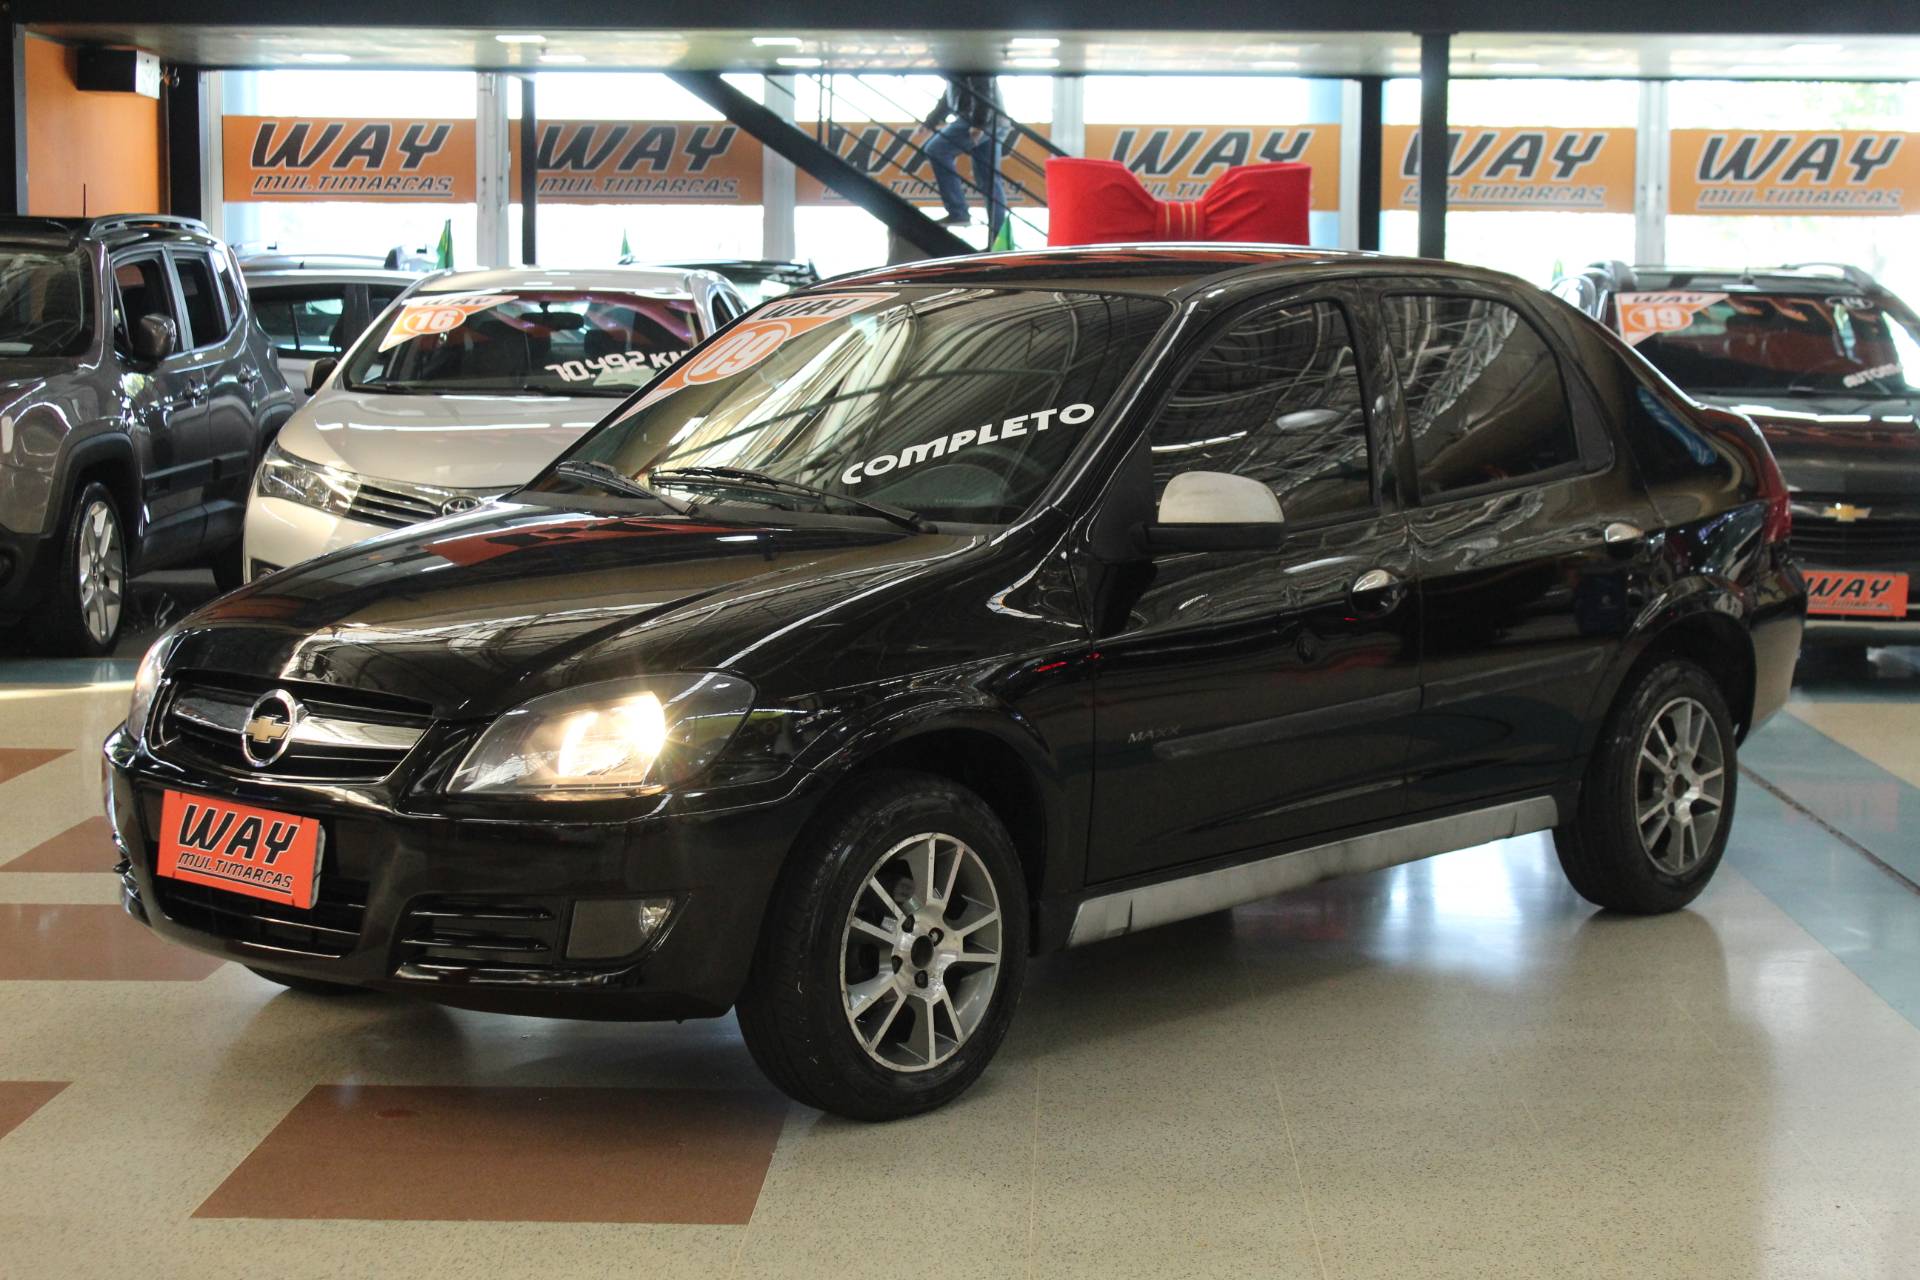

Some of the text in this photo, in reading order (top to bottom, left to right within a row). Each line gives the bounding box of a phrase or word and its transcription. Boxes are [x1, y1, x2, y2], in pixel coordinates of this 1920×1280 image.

[250, 122, 454, 171] WAY
[537, 124, 740, 173] WAY
[1112, 129, 1315, 177] WAY
[1402, 131, 1609, 181] WAY
[1696, 134, 1905, 186] WAY
[253, 175, 454, 191] MULTIMARCAS
[539, 178, 739, 194] MULTIMARCAS
[414, 310, 459, 330] 16
[1641, 307, 1681, 329] 19
[544, 351, 650, 382] 70.492
[687, 327, 787, 375] 09
[841, 403, 1095, 485] COMPLETO
[1806, 577, 1893, 599] WAY
[178, 803, 300, 866] WAY
[178, 852, 293, 889] MULTIMARCAS
